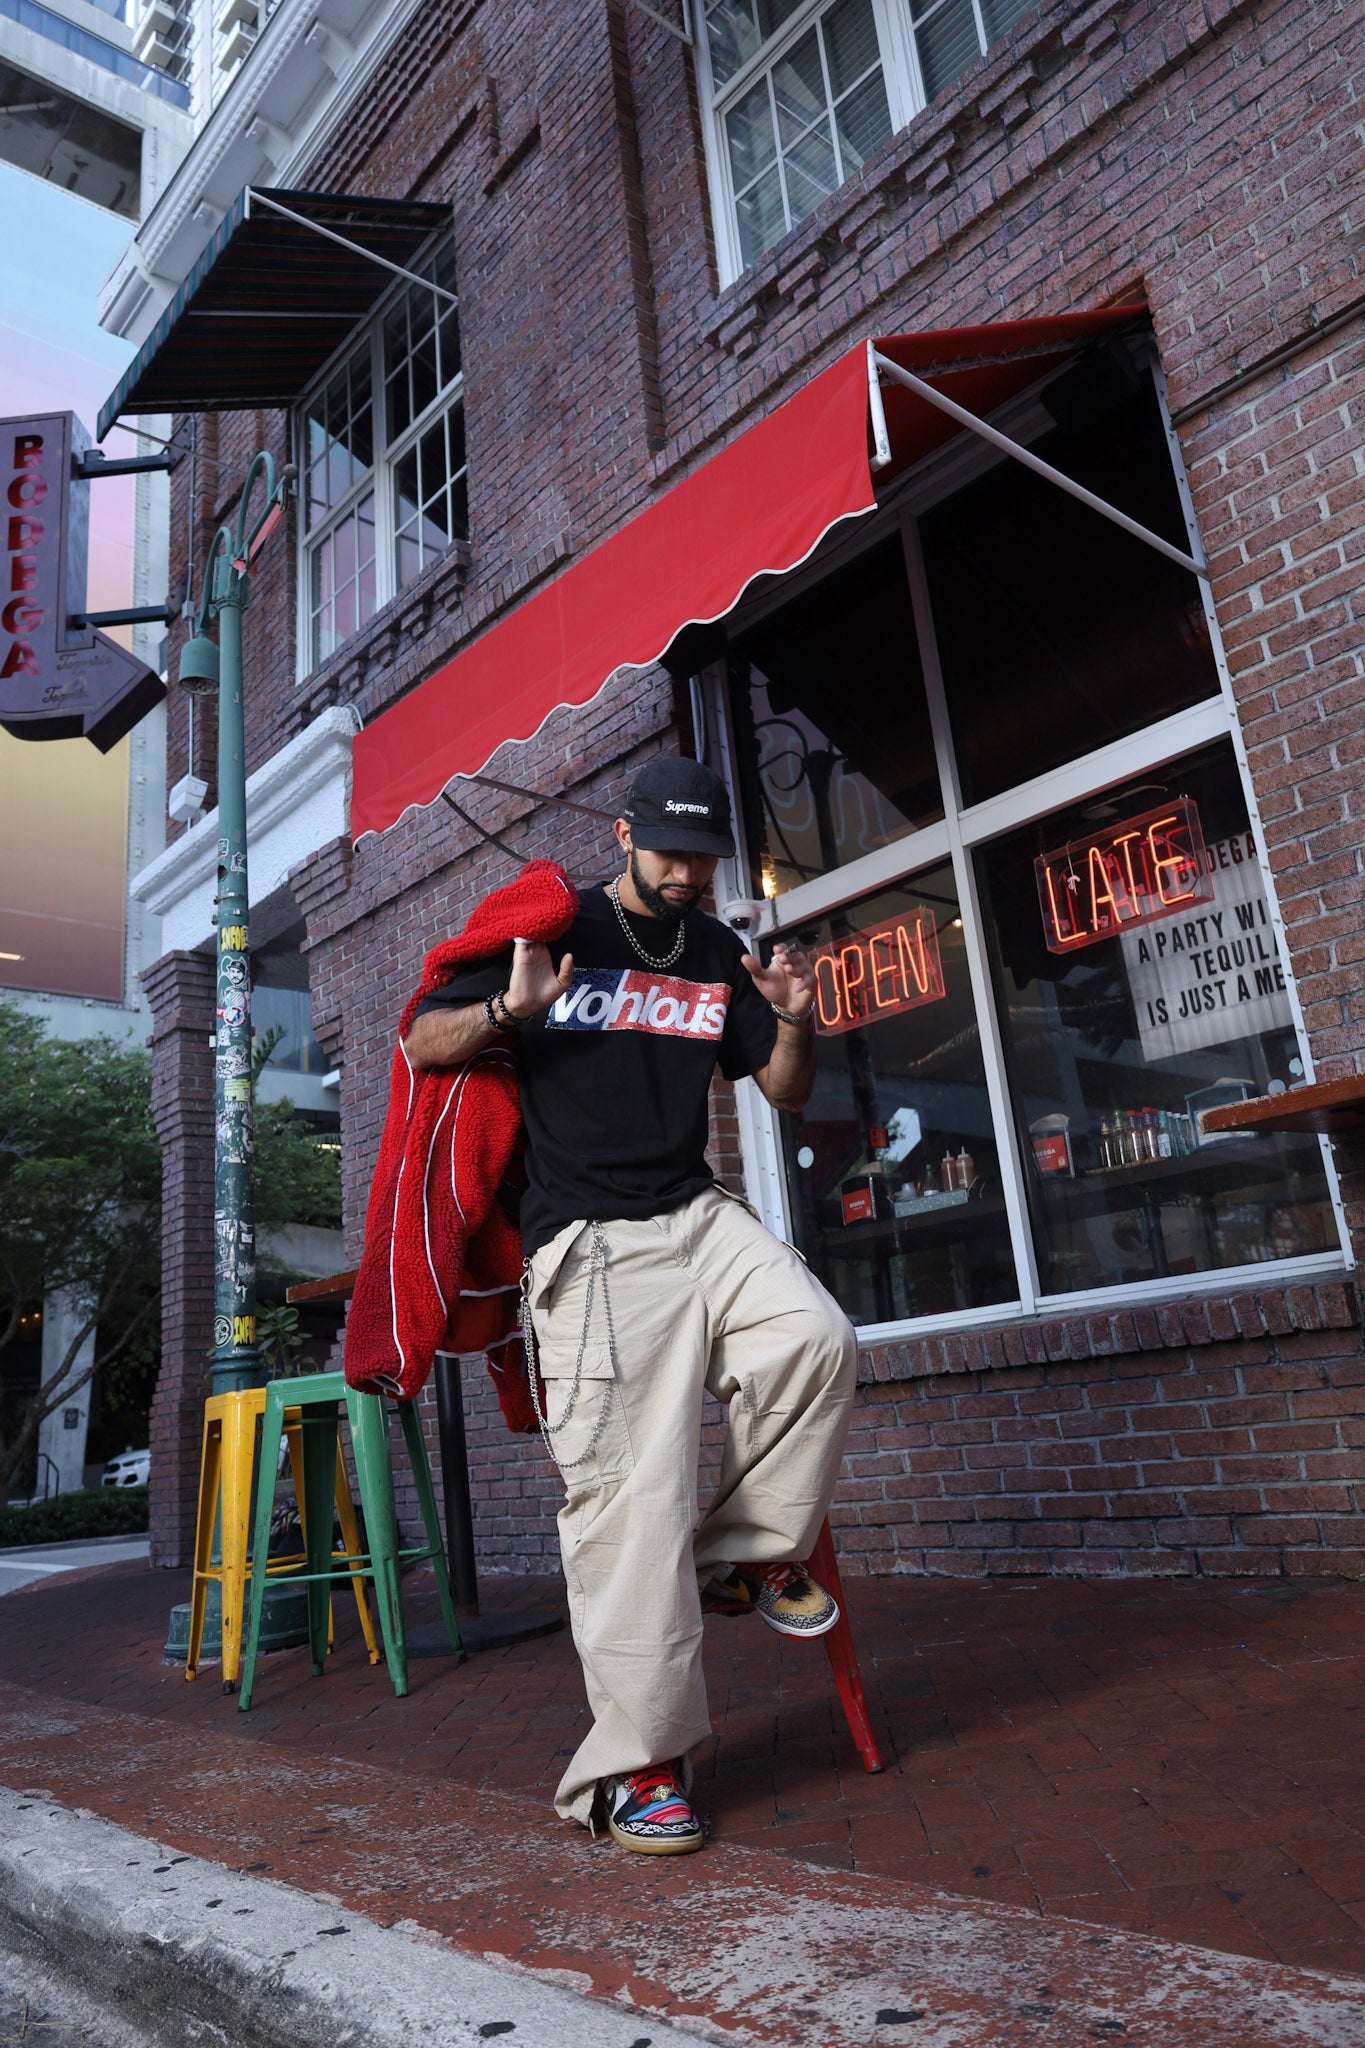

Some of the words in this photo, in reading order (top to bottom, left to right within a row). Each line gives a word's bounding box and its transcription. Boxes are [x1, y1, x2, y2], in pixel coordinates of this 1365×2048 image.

[1, 434, 48, 679] BODEGA
[665, 800, 709, 814] Supreme
[1046, 816, 1195, 942] LATE
[1138, 938, 1151, 964] A
[1155, 911, 1224, 958] PARTY
[1234, 897, 1268, 931] WI
[553, 969, 727, 1035] Vohlouis
[815, 919, 928, 1026] OPEN
[1147, 998, 1169, 1027] IS
[1179, 980, 1227, 1018] JUST
[1237, 974, 1252, 1002] A
